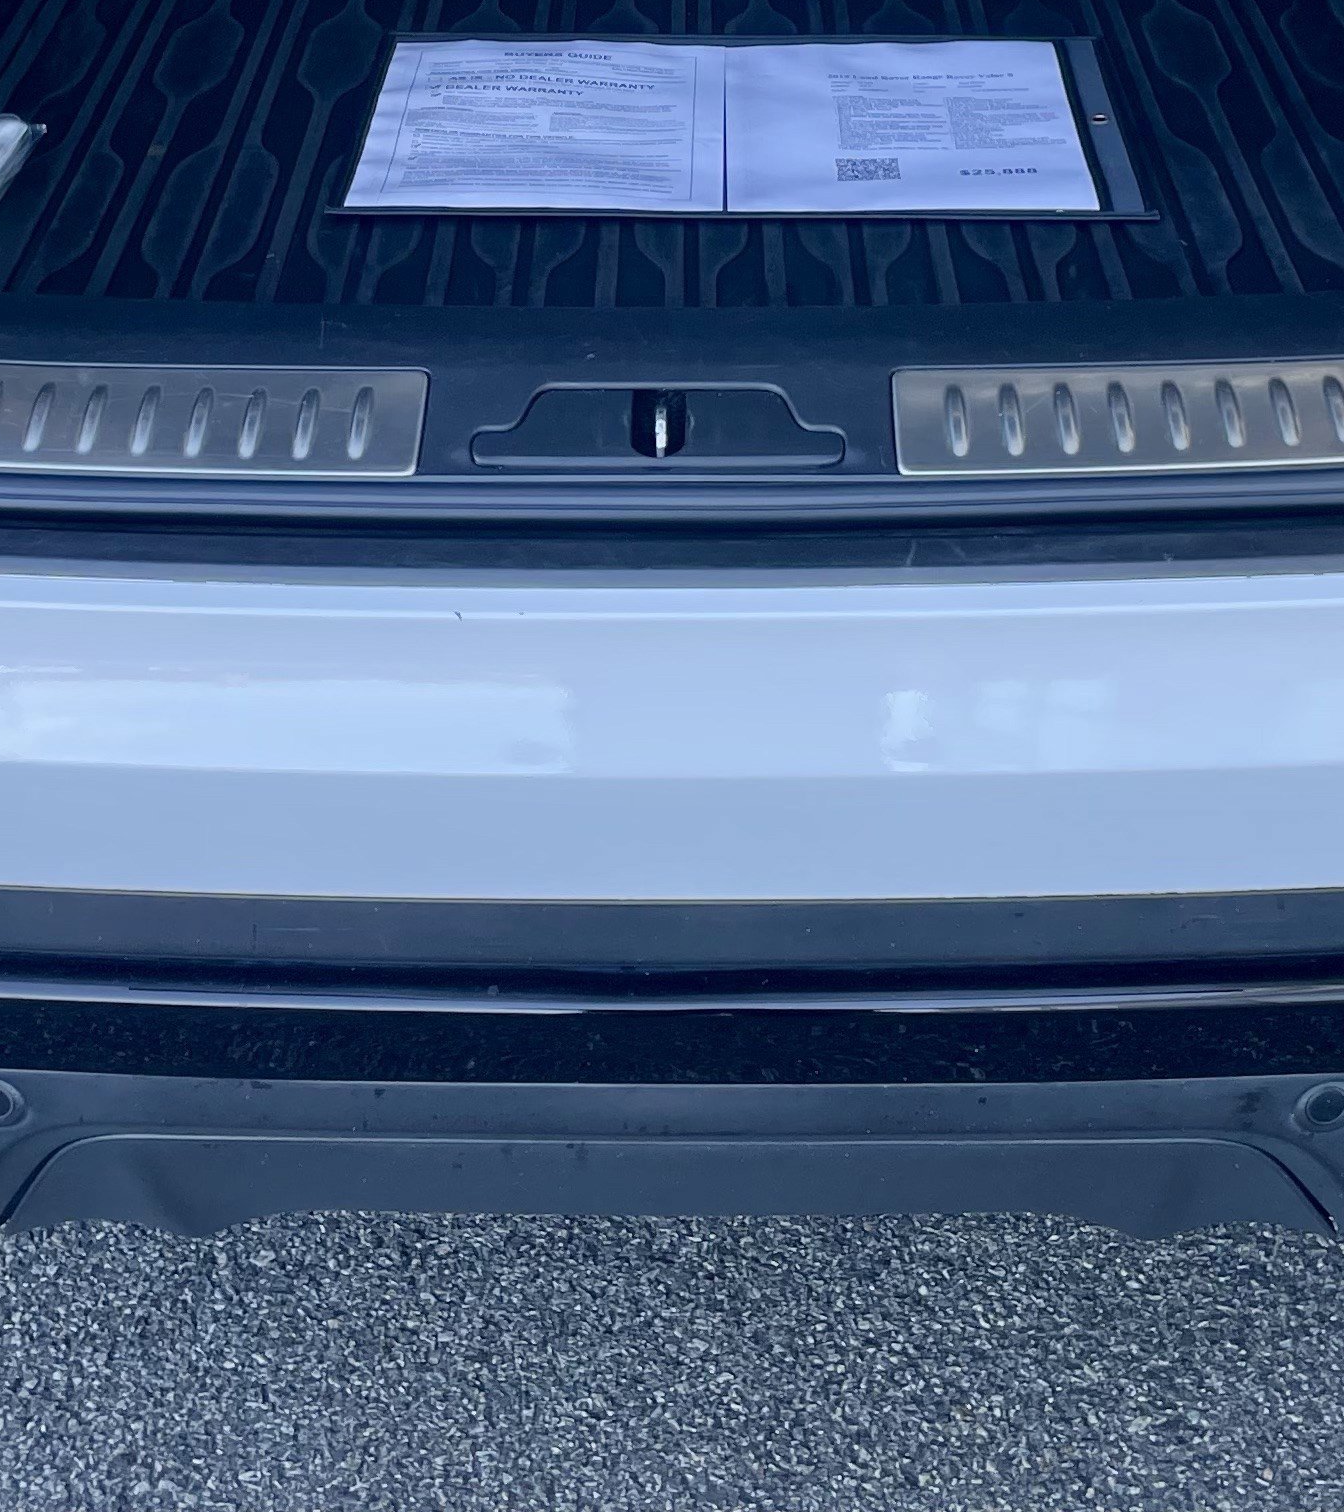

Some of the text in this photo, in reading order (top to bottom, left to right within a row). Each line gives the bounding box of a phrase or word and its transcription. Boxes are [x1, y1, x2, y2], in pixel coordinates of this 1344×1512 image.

[519, 74, 574, 84] DEALER
[577, 79, 656, 90] WARRANTY
[505, 85, 584, 96] WARRANTY
